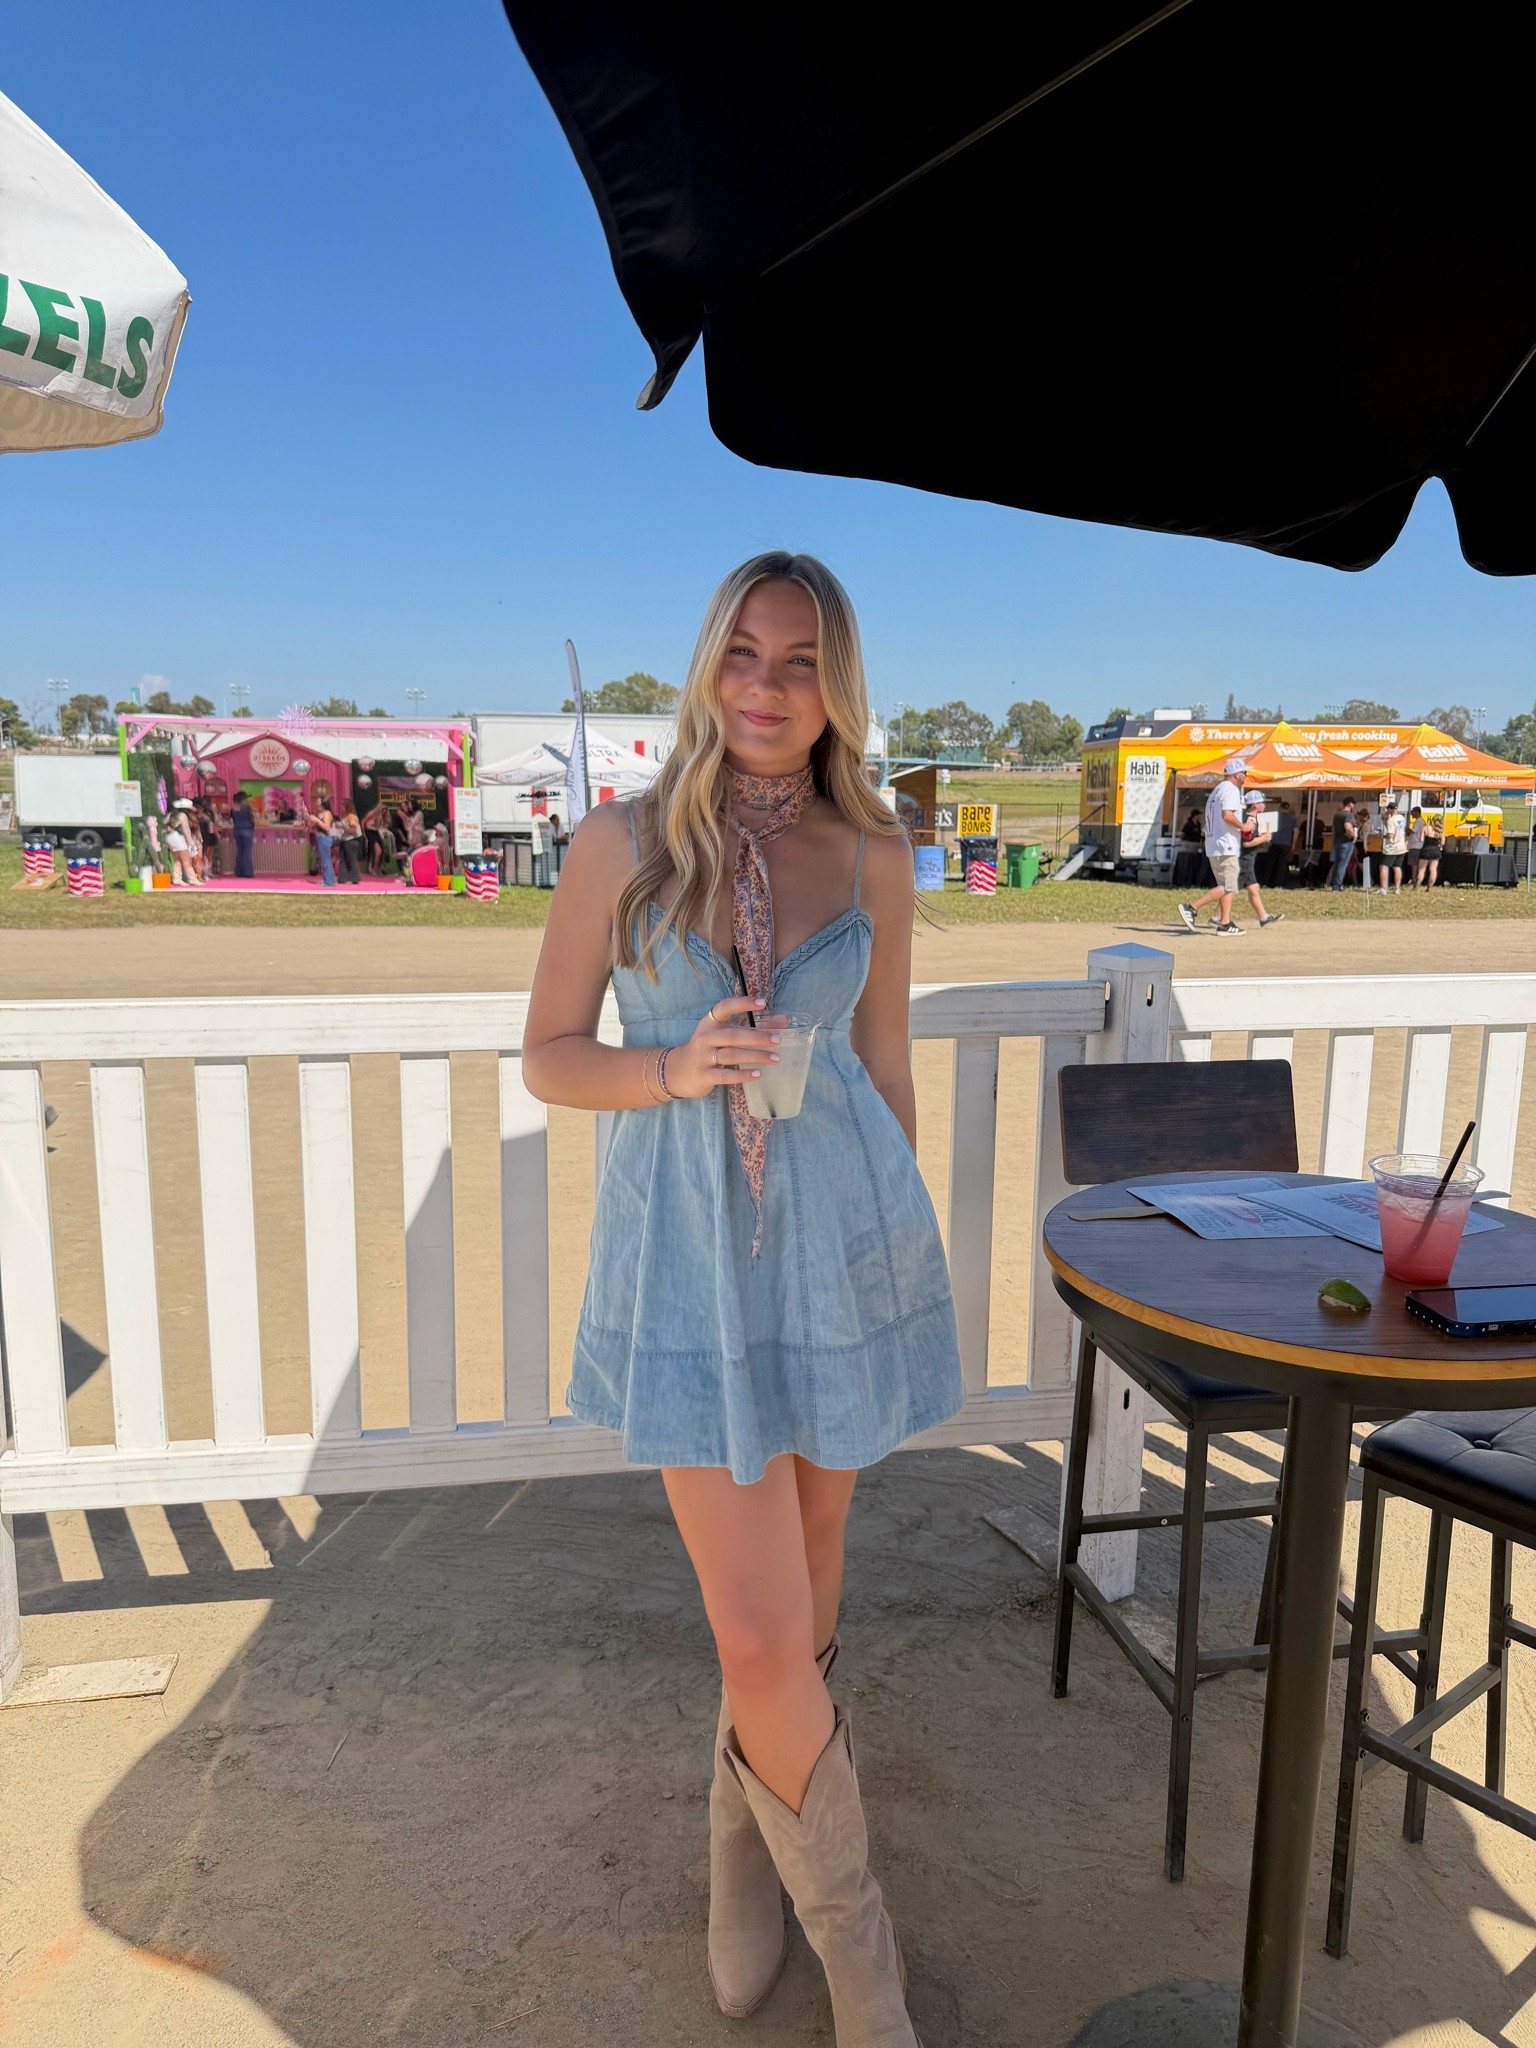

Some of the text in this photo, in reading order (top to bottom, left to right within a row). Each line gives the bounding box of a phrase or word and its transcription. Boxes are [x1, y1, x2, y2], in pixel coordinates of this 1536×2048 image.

[1207, 729, 1251, 740] There's
[1317, 730, 1349, 742] fresh
[1352, 730, 1398, 743] cooking
[1273, 742, 1322, 757] Habit
[1416, 744, 1468, 758] Habit
[1130, 761, 1160, 775] Habit
